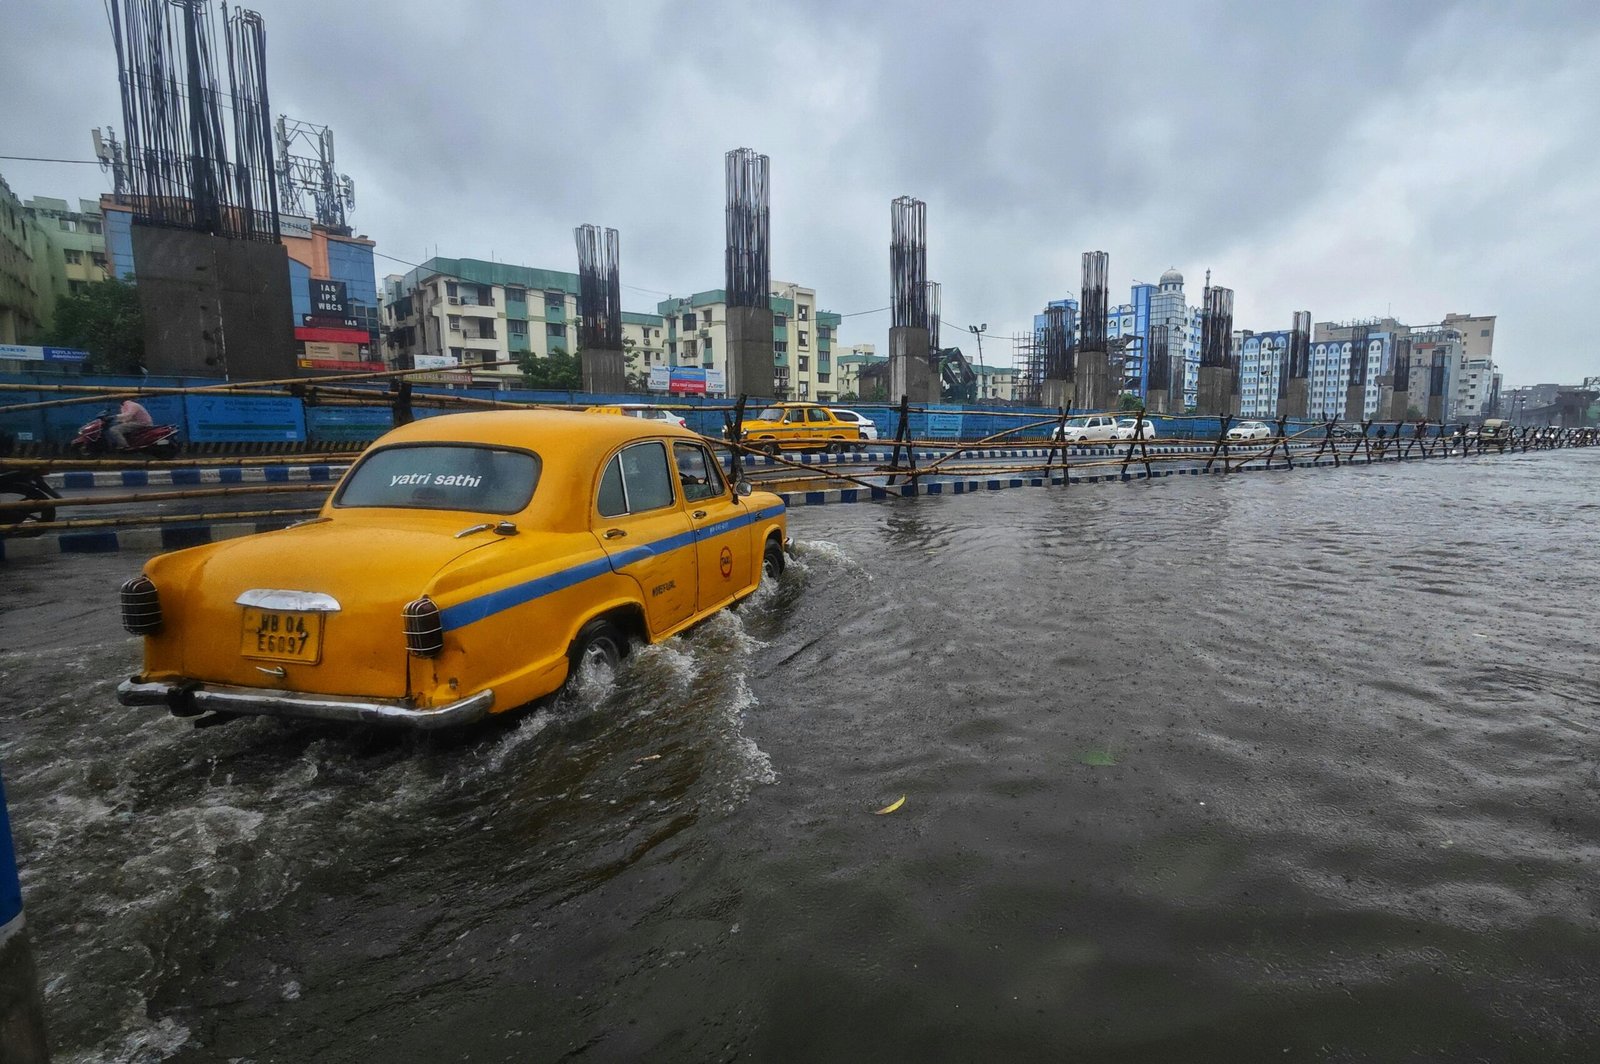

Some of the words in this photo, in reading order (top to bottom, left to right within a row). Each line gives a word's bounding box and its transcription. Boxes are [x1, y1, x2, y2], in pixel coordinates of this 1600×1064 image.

[321, 284, 336, 292] IAS
[321, 293, 336, 301] IPS
[318, 303, 342, 311] WBCS
[390, 473, 432, 486] yatri
[434, 474, 482, 487] sathi
[286, 615, 304, 633] 04
[258, 633, 308, 654] E6097
